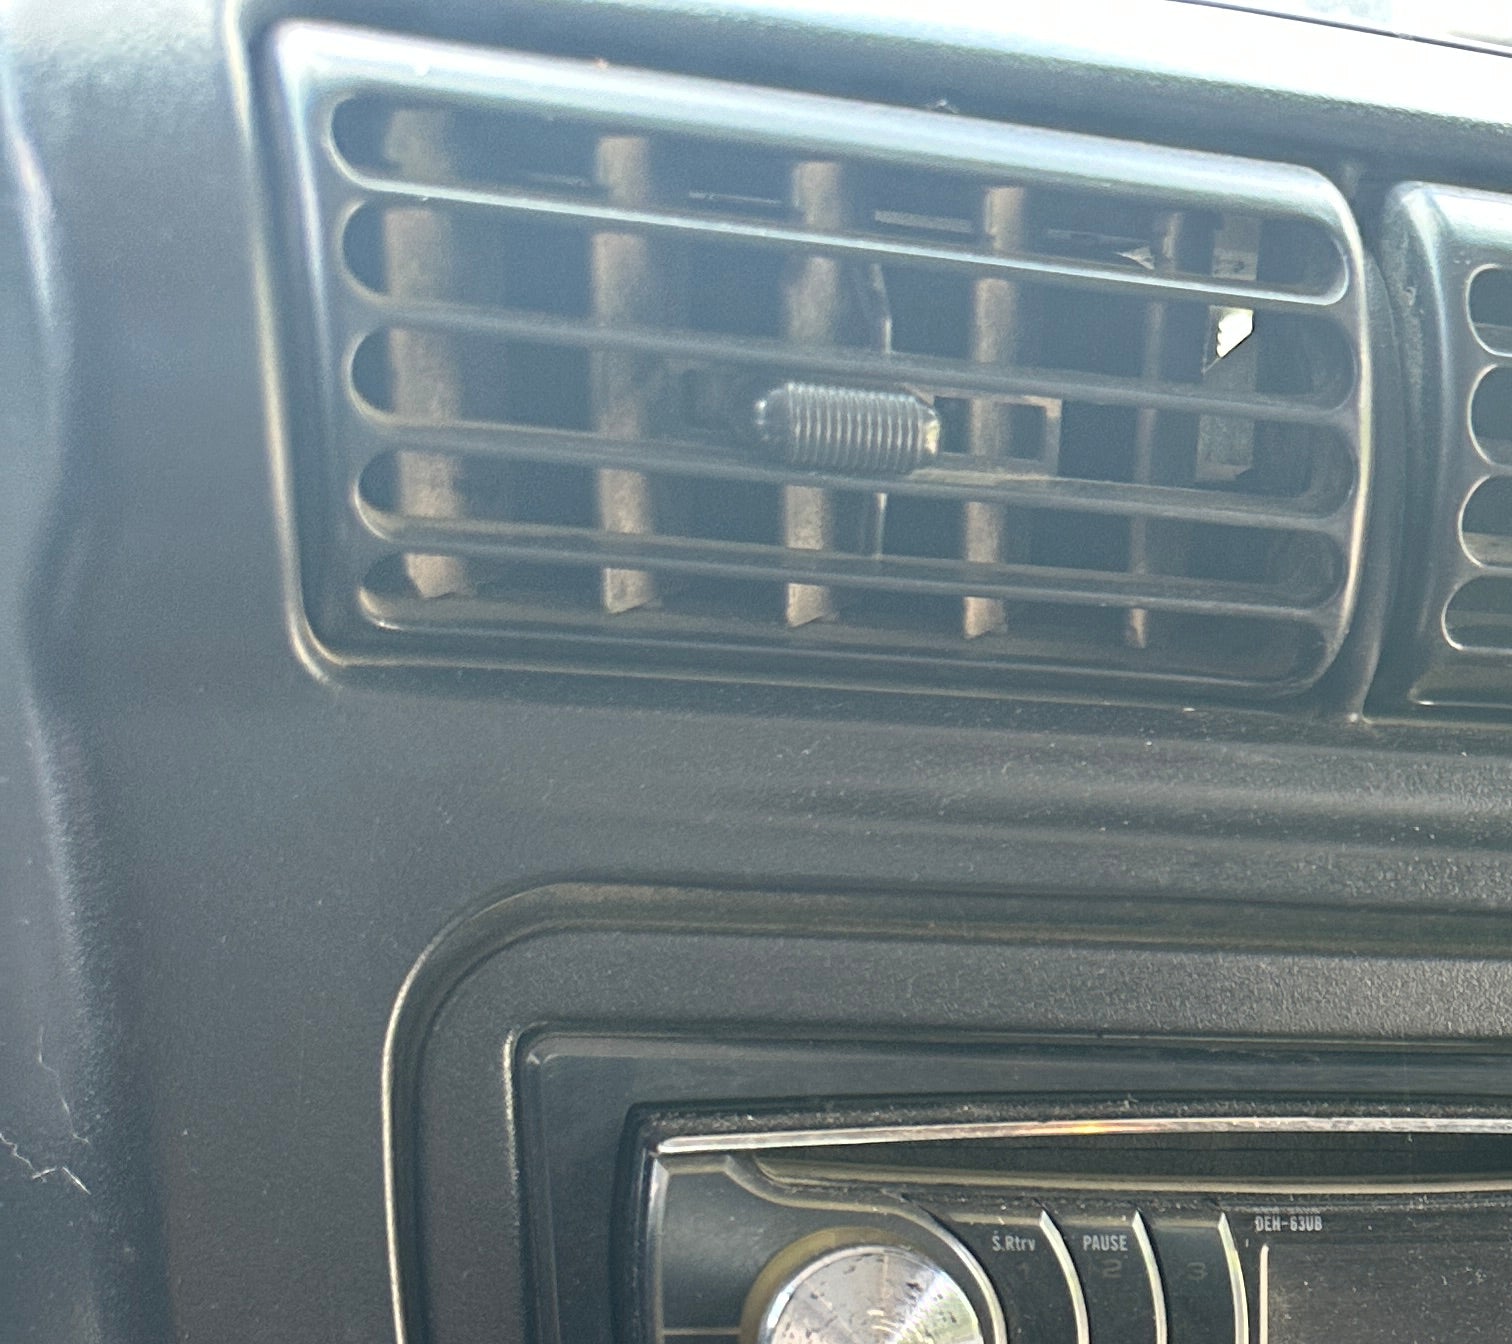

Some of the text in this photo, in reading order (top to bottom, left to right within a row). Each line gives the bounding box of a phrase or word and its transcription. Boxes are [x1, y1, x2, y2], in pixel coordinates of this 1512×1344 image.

[1083, 1235, 1128, 1251] PAUSE
[1103, 1259, 1122, 1279] 2
[1187, 1262, 1206, 1280] 3
